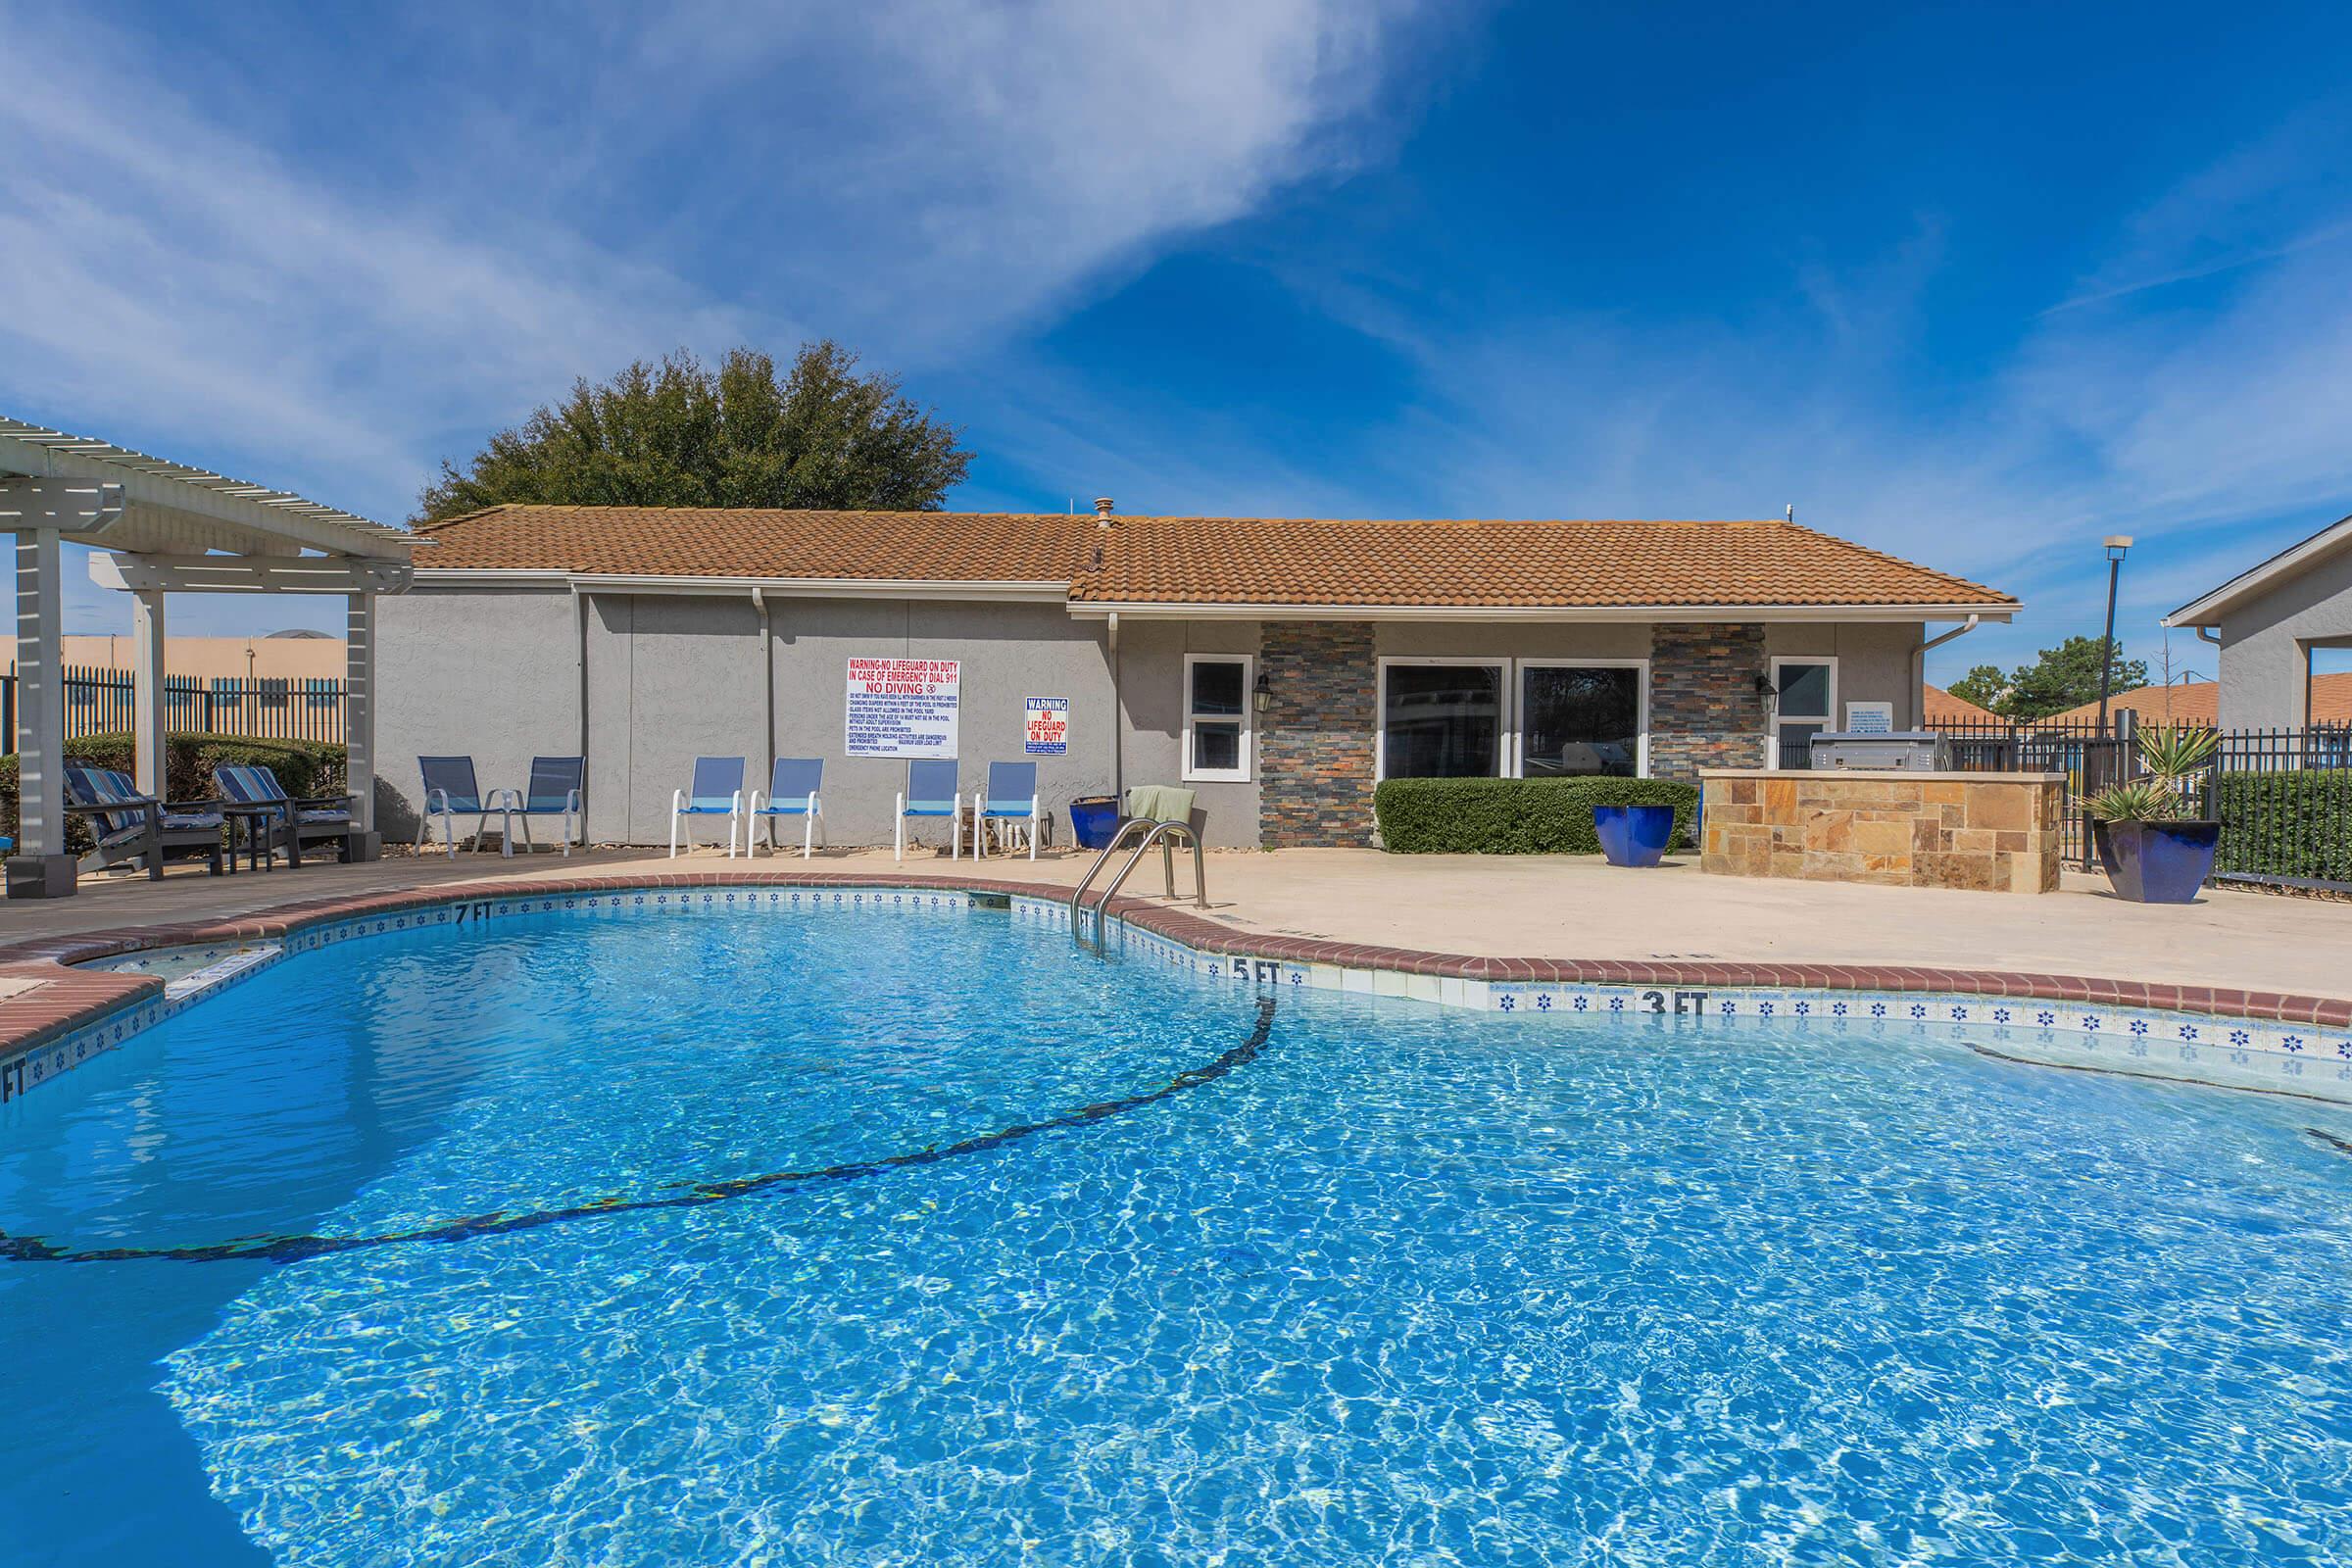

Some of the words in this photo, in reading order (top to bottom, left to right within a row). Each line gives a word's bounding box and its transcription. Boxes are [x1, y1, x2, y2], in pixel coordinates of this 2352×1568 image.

[893, 661, 927, 671] LIFEGUARD
[929, 662, 939, 671] ON
[941, 662, 957, 672] DUTY
[849, 671, 856, 680] IN
[858, 671, 874, 681] CASE
[877, 671, 885, 681] OF
[887, 671, 927, 682] EMERGENCY
[929, 672, 944, 682] DIAL
[946, 673, 956, 683] 911
[866, 682, 882, 693] NO
[886, 683, 923, 694] DIVING
[1029, 700, 1066, 710] WARNING
[1042, 710, 1052, 720] NO
[1027, 721, 1066, 731] LIFEGUARD
[1031, 731, 1040, 741] ON
[1044, 731, 1061, 741] DUTY
[456, 904, 469, 924] 7
[474, 902, 493, 921] FT
[1233, 958, 1250, 980] 5
[1255, 960, 1280, 984] FT
[1641, 991, 1666, 1013] 3
[1675, 992, 1708, 1014] FT
[2, 1057, 25, 1103] FT
